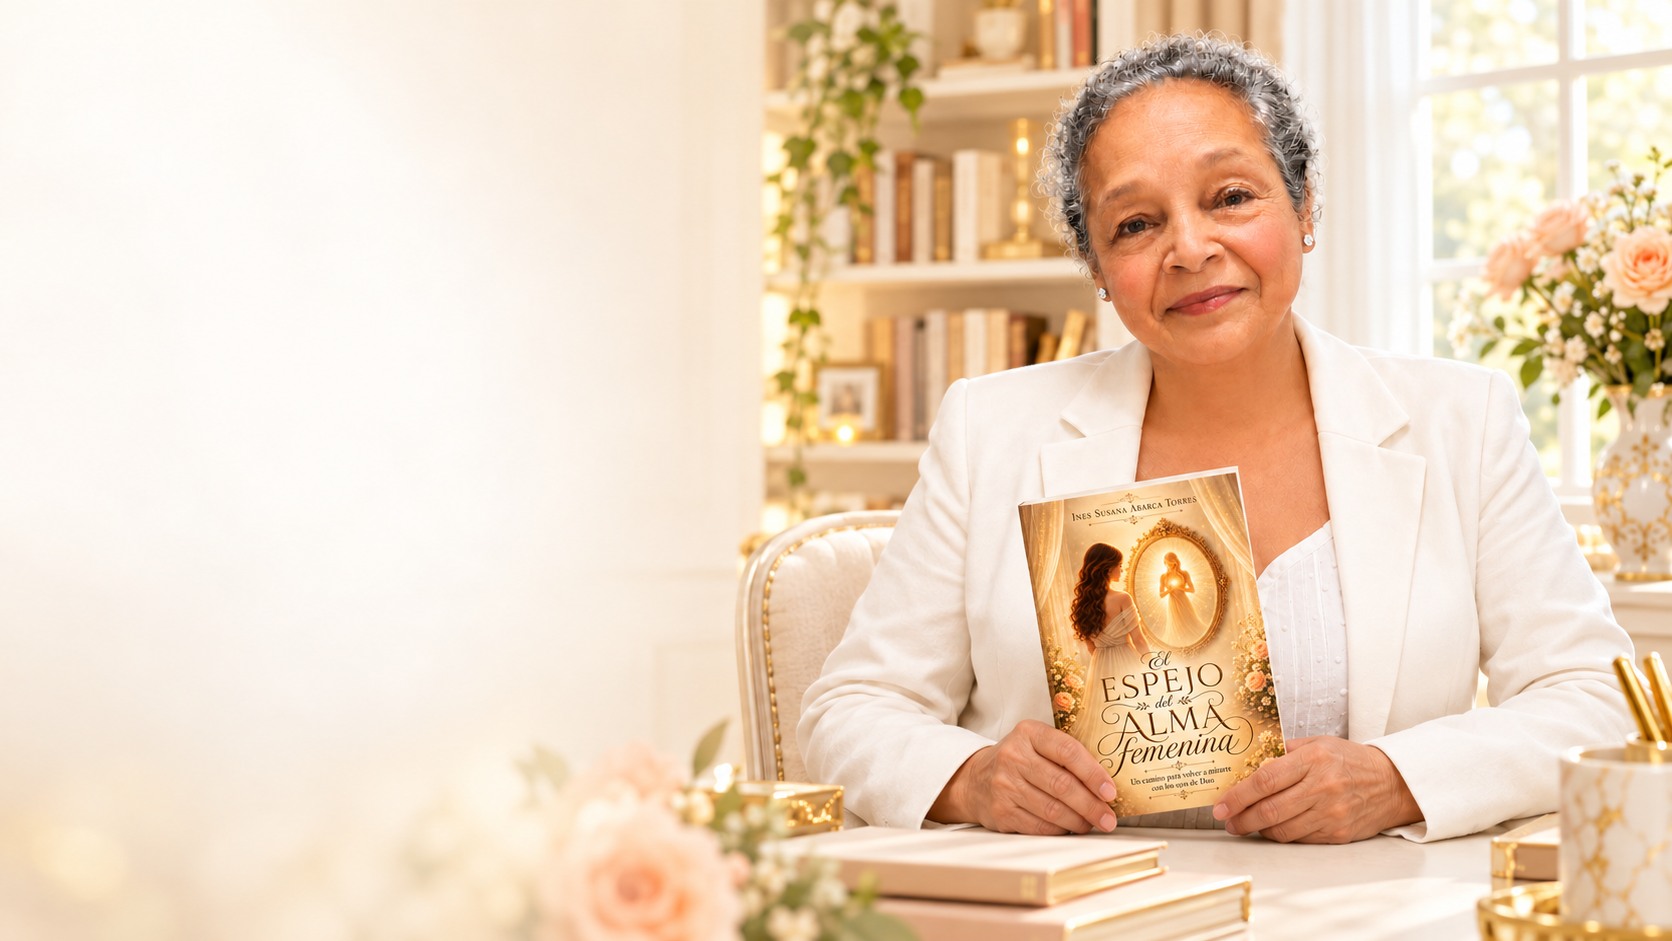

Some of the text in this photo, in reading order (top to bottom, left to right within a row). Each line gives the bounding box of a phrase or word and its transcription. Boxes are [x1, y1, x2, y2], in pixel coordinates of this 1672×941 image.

[1072, 496, 1197, 522] INES SUSANA ABARCA TORRES
[1140, 651, 1171, 670] El
[1101, 663, 1223, 702] ESPEJO
[1154, 694, 1173, 709] del
[1098, 698, 1240, 756] ALMA
[1108, 733, 1253, 778] femenina
